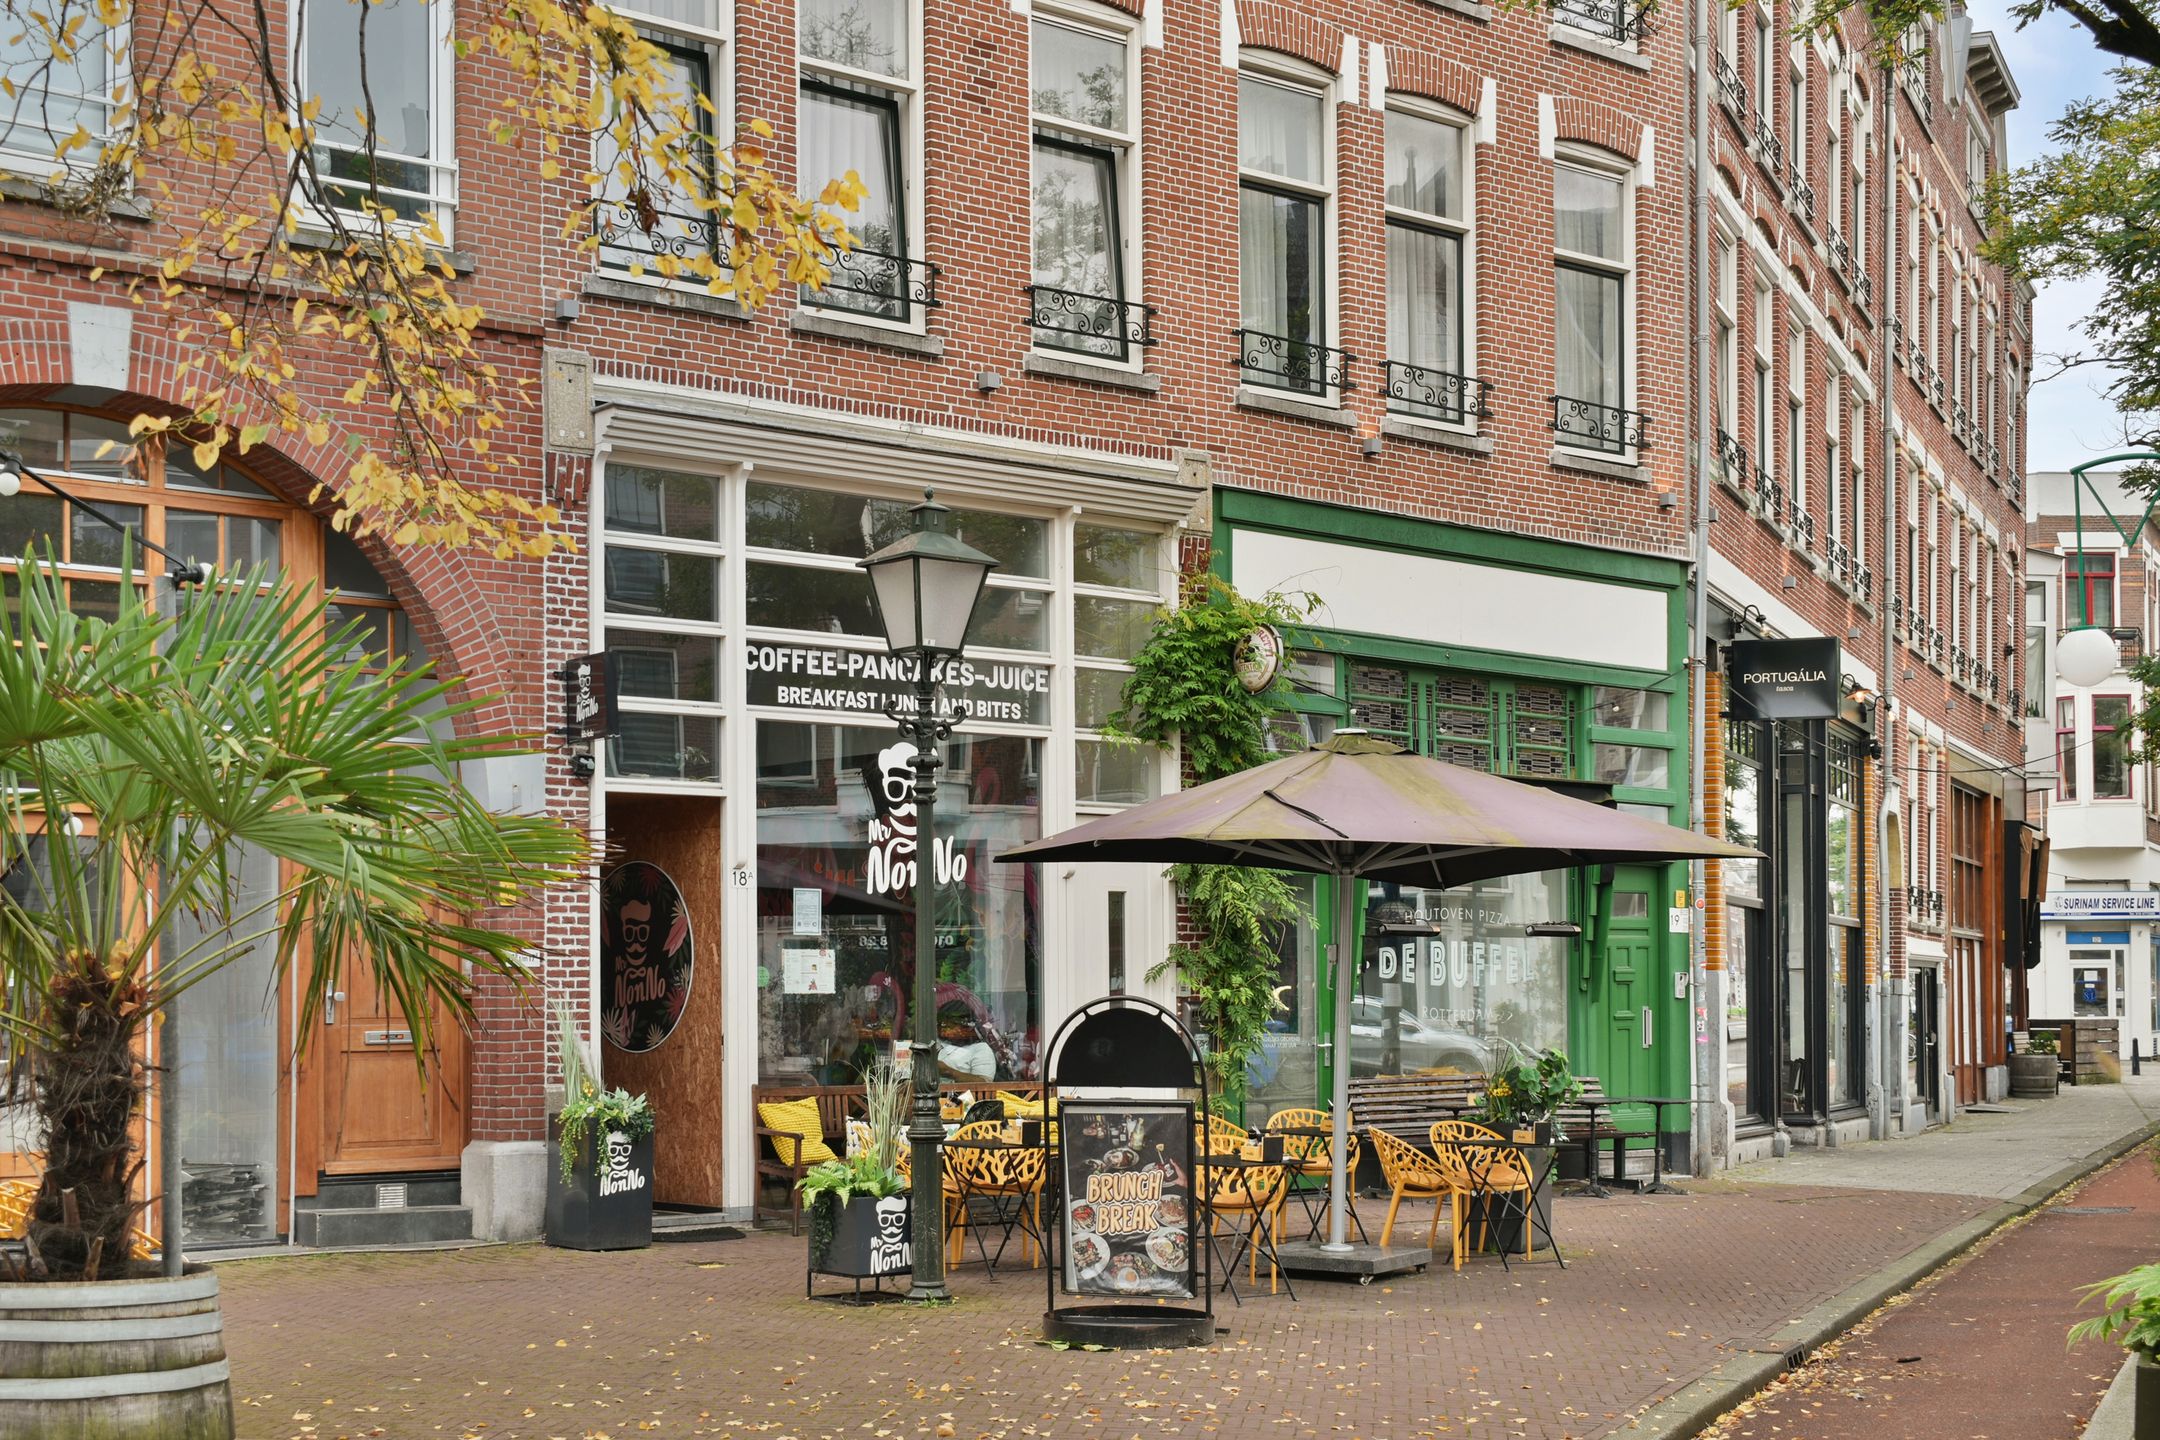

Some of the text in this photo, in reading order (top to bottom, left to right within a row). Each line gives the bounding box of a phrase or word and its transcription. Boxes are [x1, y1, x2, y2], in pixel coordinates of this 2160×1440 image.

[1743, 667, 1827, 684] PORTUGÁLIA
[777, 686, 878, 710] BREAKFAST
[940, 698, 974, 716] AND
[977, 700, 1022, 720] BITES
[868, 818, 892, 844] Mr
[1404, 907, 1511, 926] HOUTOVEN PIZZA
[2064, 898, 2155, 910] SURINAM SERVICE LINE
[1671, 914, 1680, 926] 19
[1378, 940, 1536, 989] DE BUFFEL
[615, 964, 666, 1008] NonNo
[1423, 1006, 1494, 1022] ROTTERDAM
[600, 1168, 645, 1197] NonNo
[1087, 1170, 1164, 1204] BRUNCH
[1096, 1202, 1160, 1235] BREAK
[870, 1242, 912, 1275] NonN
